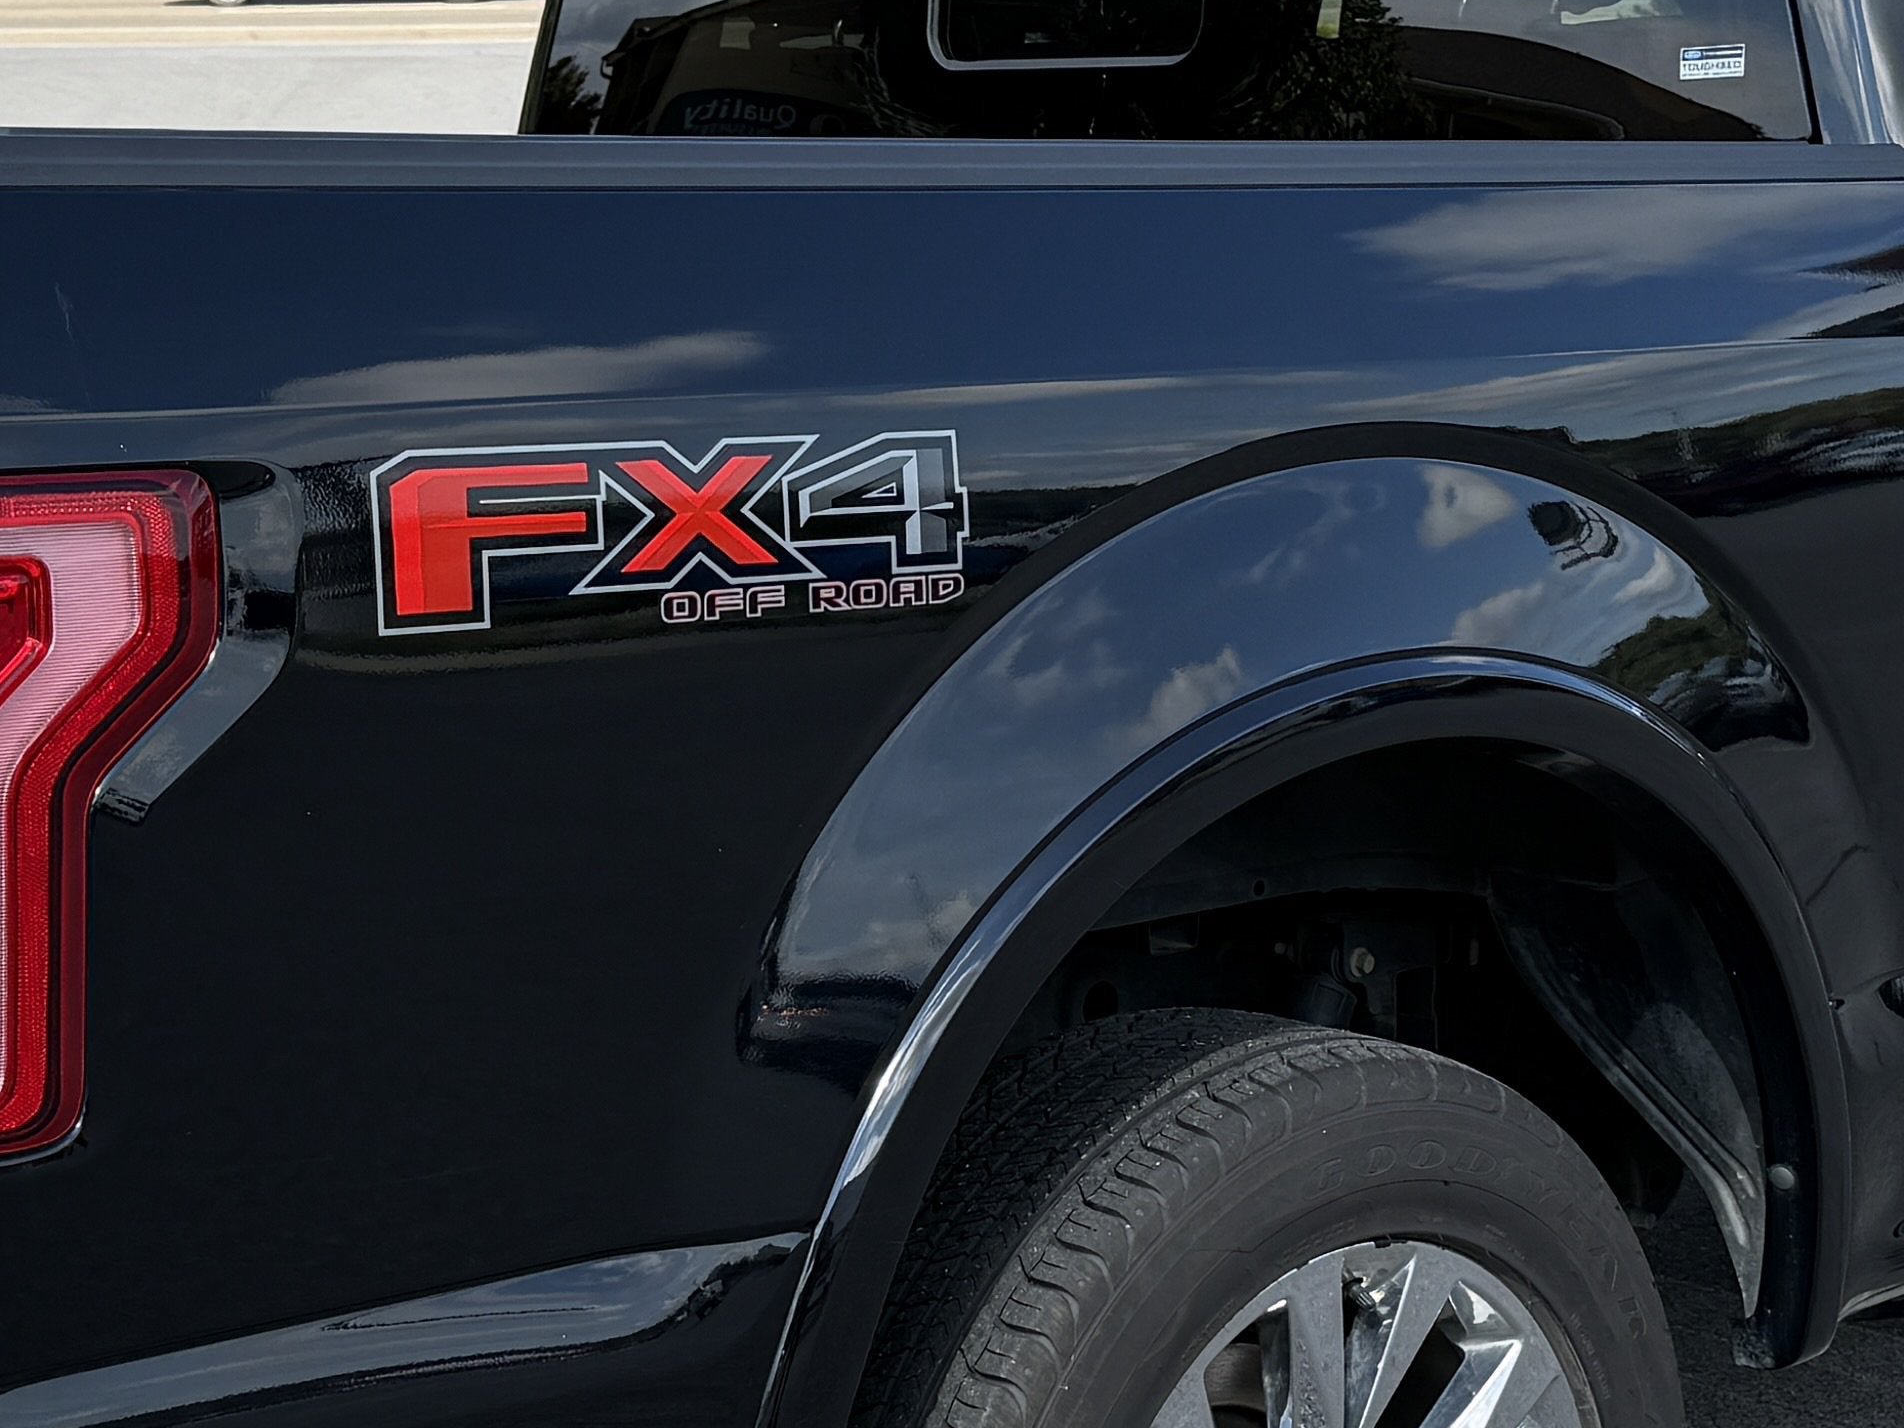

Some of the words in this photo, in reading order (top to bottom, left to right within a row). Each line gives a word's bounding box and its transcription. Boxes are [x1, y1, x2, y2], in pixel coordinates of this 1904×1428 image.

[370, 429, 969, 636] FX4
[660, 585, 786, 624] OFF
[808, 573, 965, 613] ROAD
